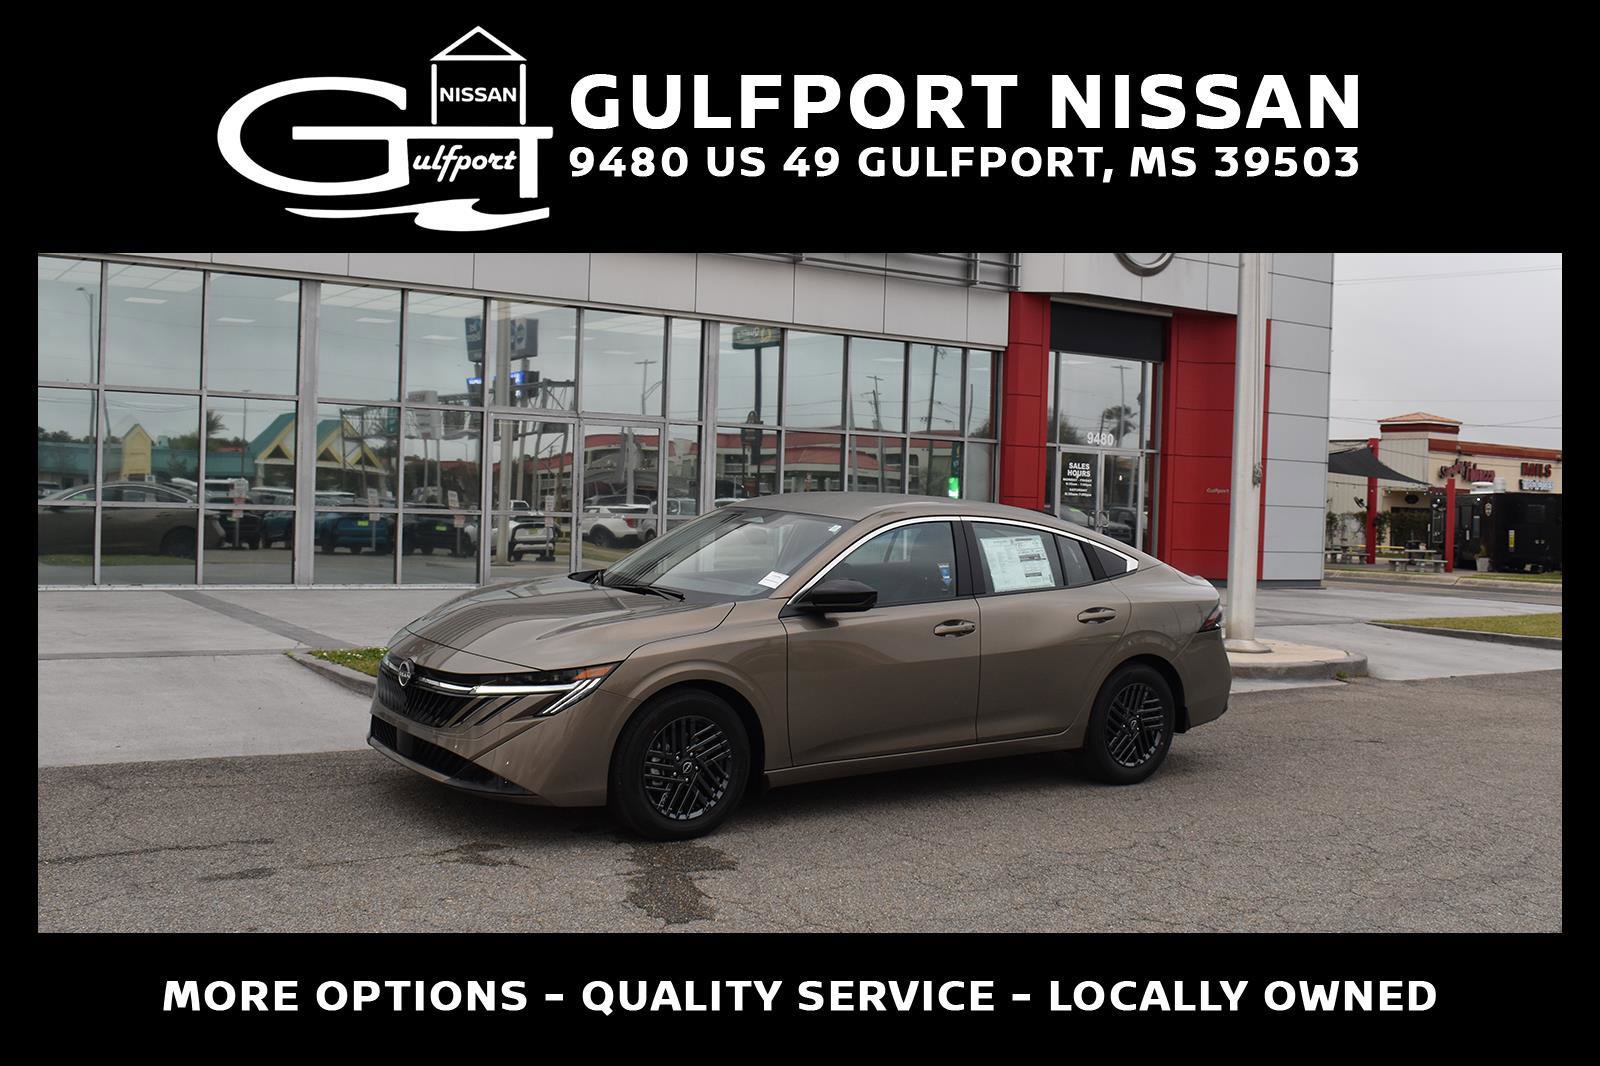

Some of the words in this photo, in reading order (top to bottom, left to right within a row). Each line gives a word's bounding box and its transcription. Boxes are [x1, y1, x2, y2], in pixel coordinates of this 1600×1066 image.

[1087, 431, 1114, 446] 9480
[1068, 462, 1090, 470] SALES
[1067, 469, 1091, 478] HOURS
